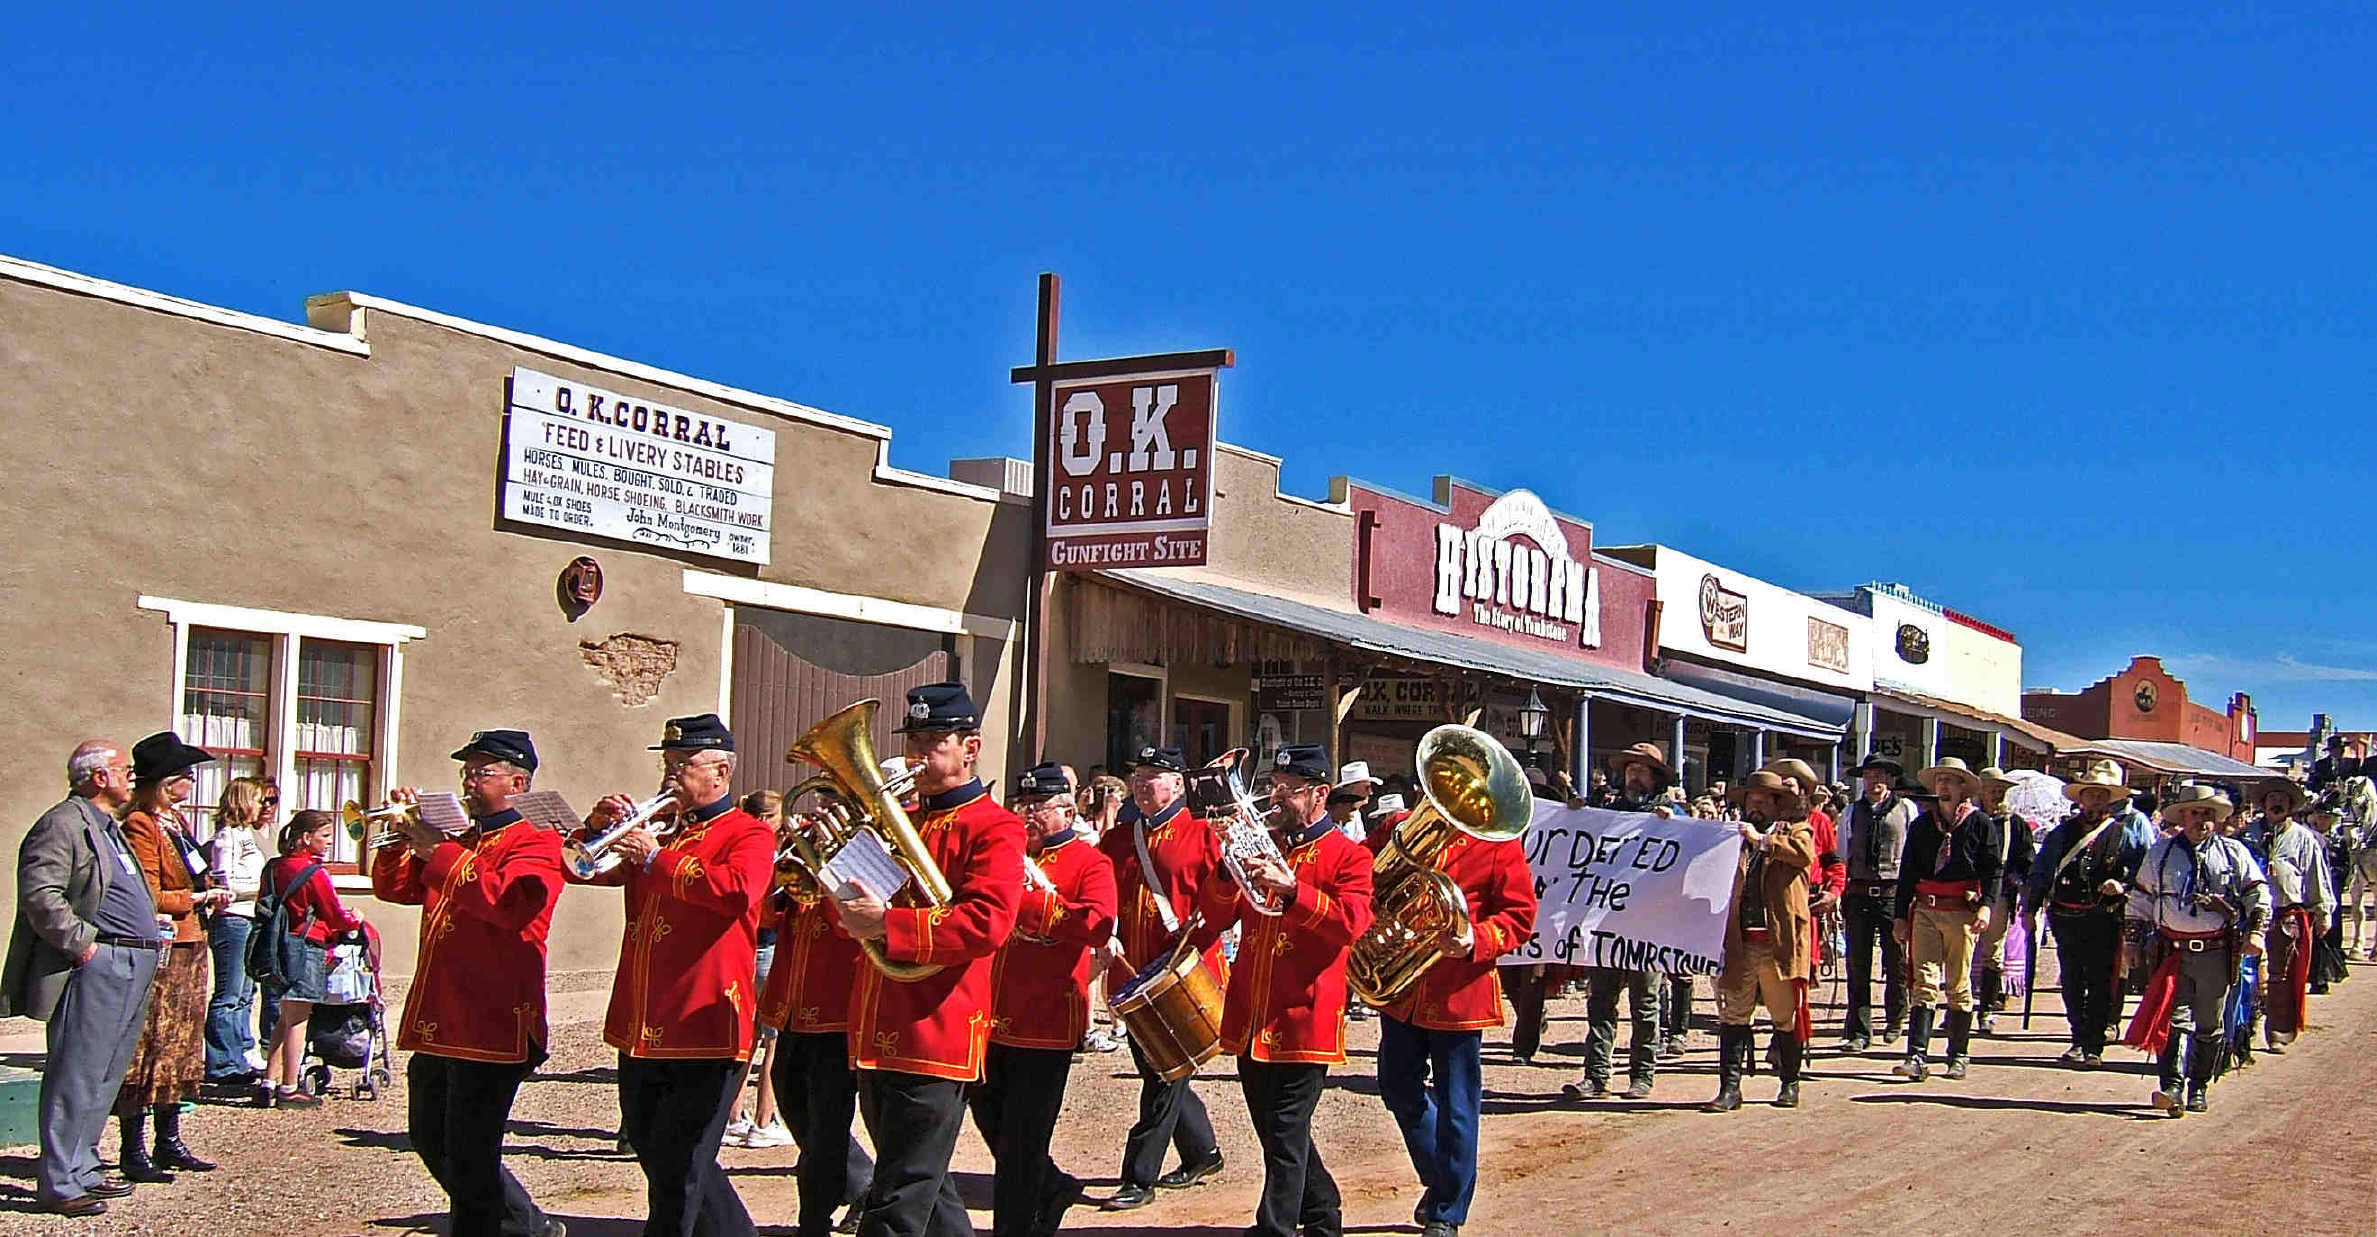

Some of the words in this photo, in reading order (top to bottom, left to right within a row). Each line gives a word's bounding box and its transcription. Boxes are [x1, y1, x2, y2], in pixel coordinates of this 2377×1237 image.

[1060, 384, 1198, 477] O.K.
[545, 423, 589, 451] FEED
[610, 436, 667, 468] LIVERY
[673, 452, 744, 484] STABLES
[522, 504, 544, 518] MADE
[549, 508, 559, 521] TO
[523, 489, 544, 505] MULE
[566, 498, 592, 514] SHOES
[587, 482, 620, 502] HORSE
[676, 500, 735, 523] BLACKSMITH
[738, 512, 763, 528] WORK
[701, 486, 737, 506] TRADED
[1059, 479, 1198, 520] CORRAL
[626, 507, 652, 526] John
[657, 513, 721, 543] Montgomery
[1436, 521, 1601, 649] HISTORAMA
[1473, 603, 1491, 624] The
[1491, 606, 1514, 635] Story
[1514, 614, 1524, 633] of
[1524, 615, 1568, 642] Tombstone
[1706, 591, 1744, 624] WESTERN
[1728, 621, 1744, 640] WAY
